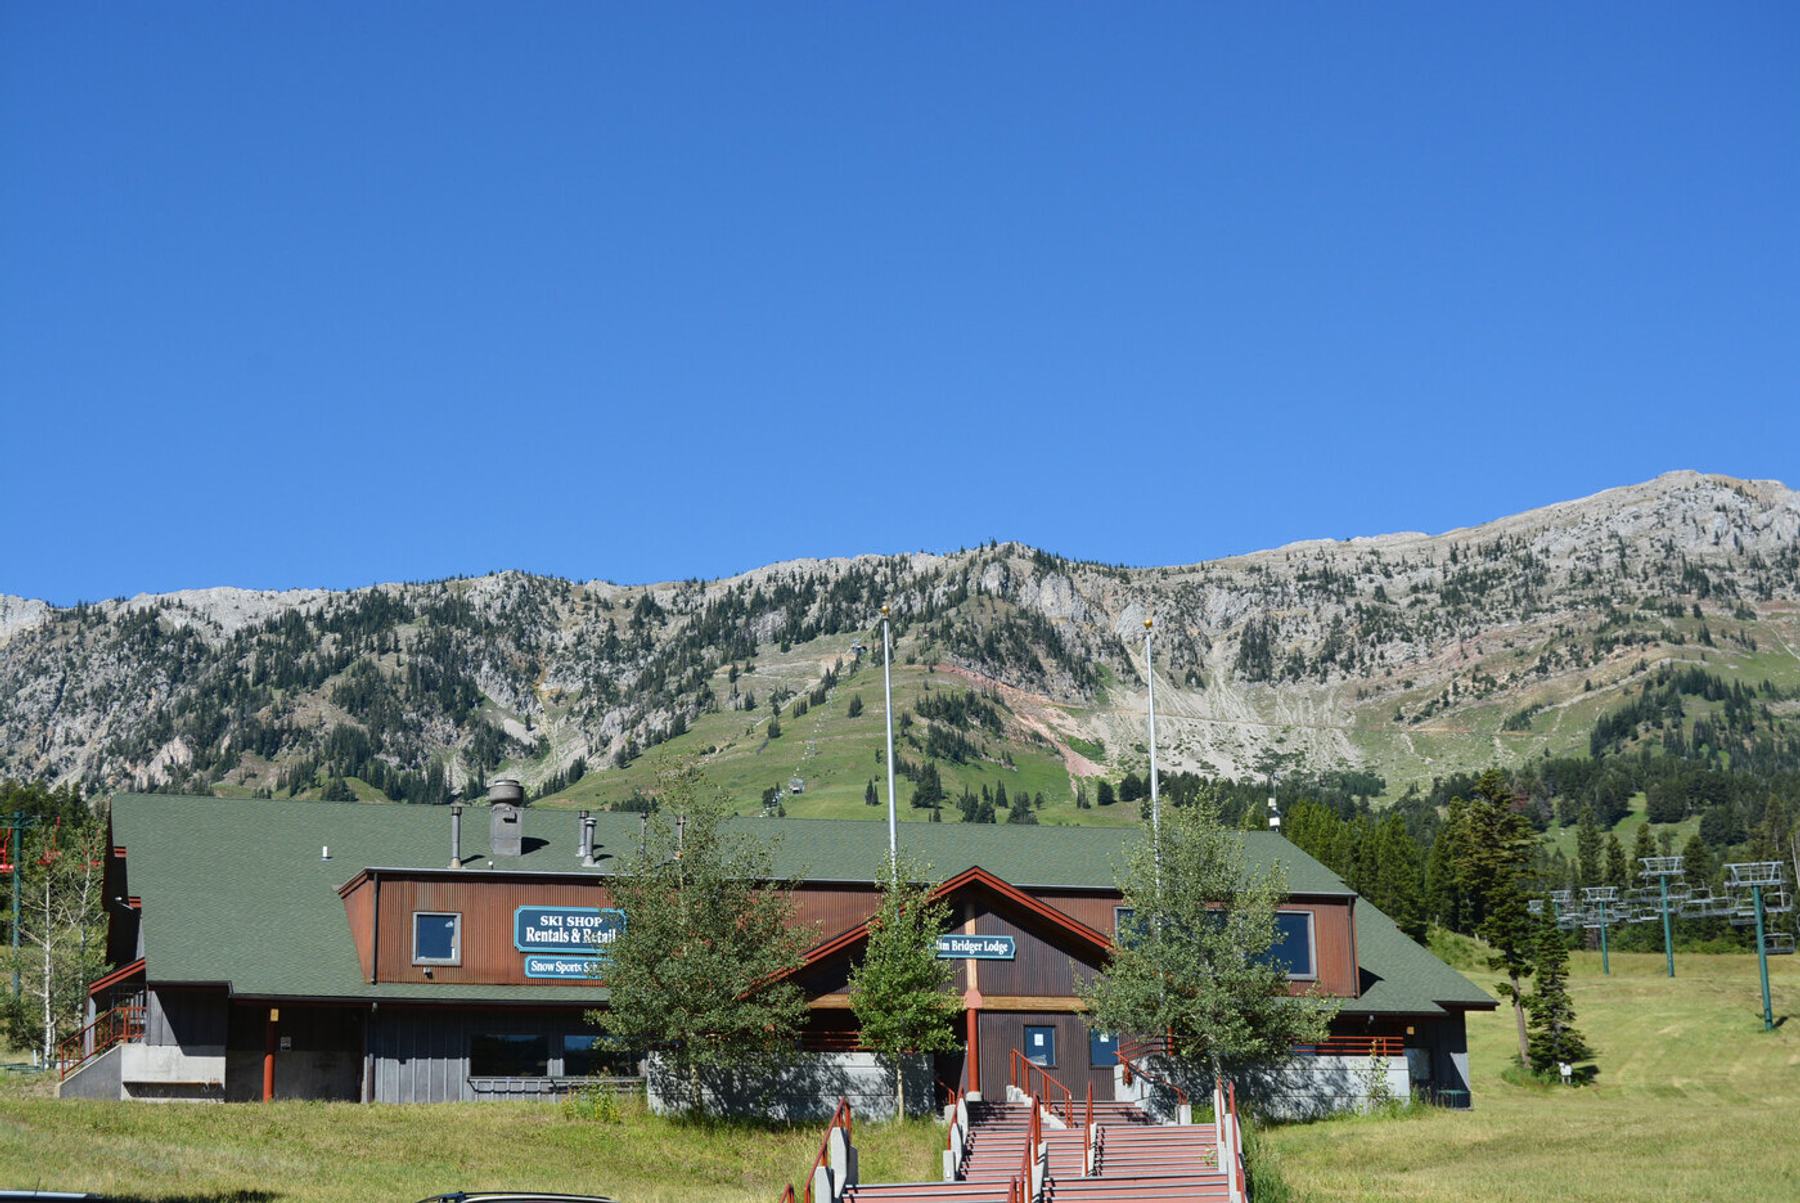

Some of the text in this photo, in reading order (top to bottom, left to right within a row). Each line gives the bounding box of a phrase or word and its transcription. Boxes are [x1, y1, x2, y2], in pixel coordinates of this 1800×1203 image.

[540, 915, 603, 927] SKI SHOP
[526, 926, 616, 943] Rentals & Retail
[951, 940, 982, 954] Bridger
[984, 941, 1008, 955] Lodge
[531, 960, 554, 972] Snow
[555, 961, 582, 974] Sports
